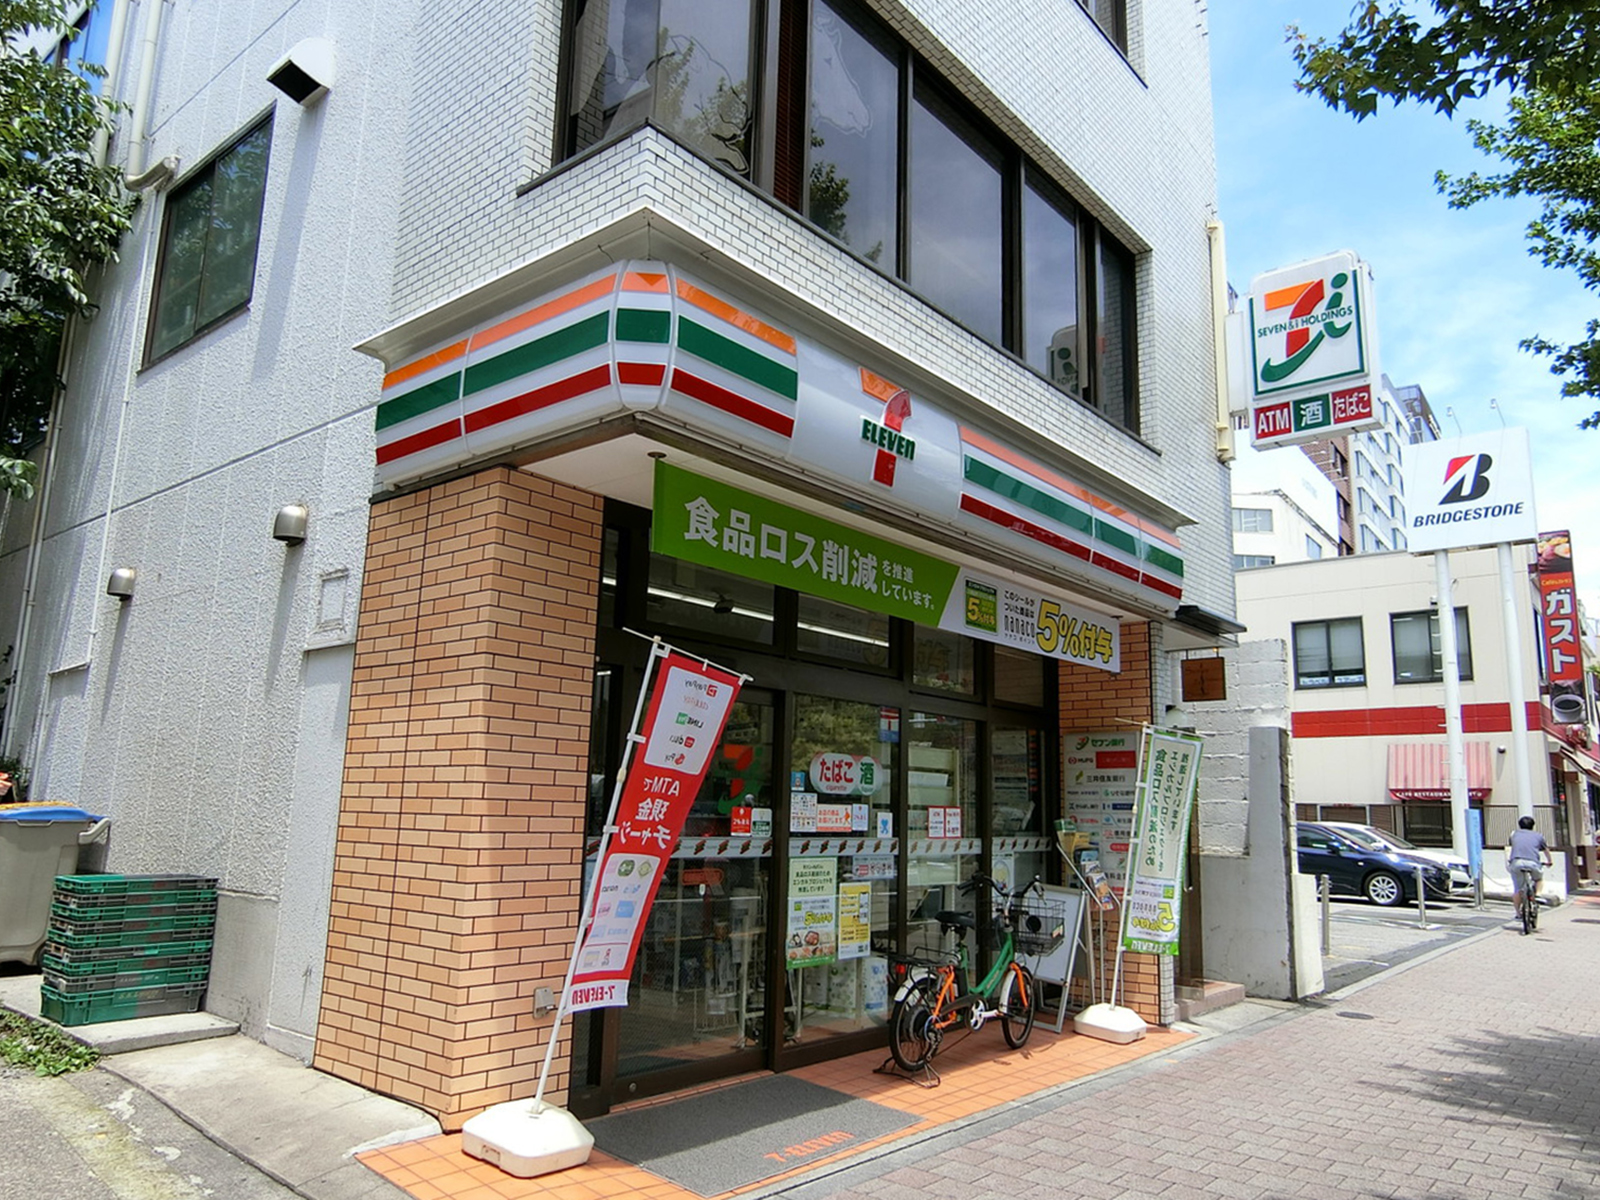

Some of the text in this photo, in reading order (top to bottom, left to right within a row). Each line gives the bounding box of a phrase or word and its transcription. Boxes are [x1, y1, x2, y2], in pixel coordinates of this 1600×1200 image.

[1300, 305, 1353, 327] HOLDINGS
[1300, 403, 1323, 426] 酒
[1333, 392, 1371, 418] たばこ
[1257, 410, 1291, 435] ATM
[684, 496, 878, 594] 食品ロス削減
[881, 559, 914, 583] を推進
[881, 581, 935, 610] しています。
[1003, 614, 1035, 639] nanaco
[1036, 598, 1113, 664] 5%付与
[1545, 587, 1576, 674] ガスト
[819, 758, 854, 783] たばこ
[860, 762, 875, 785] 酒
